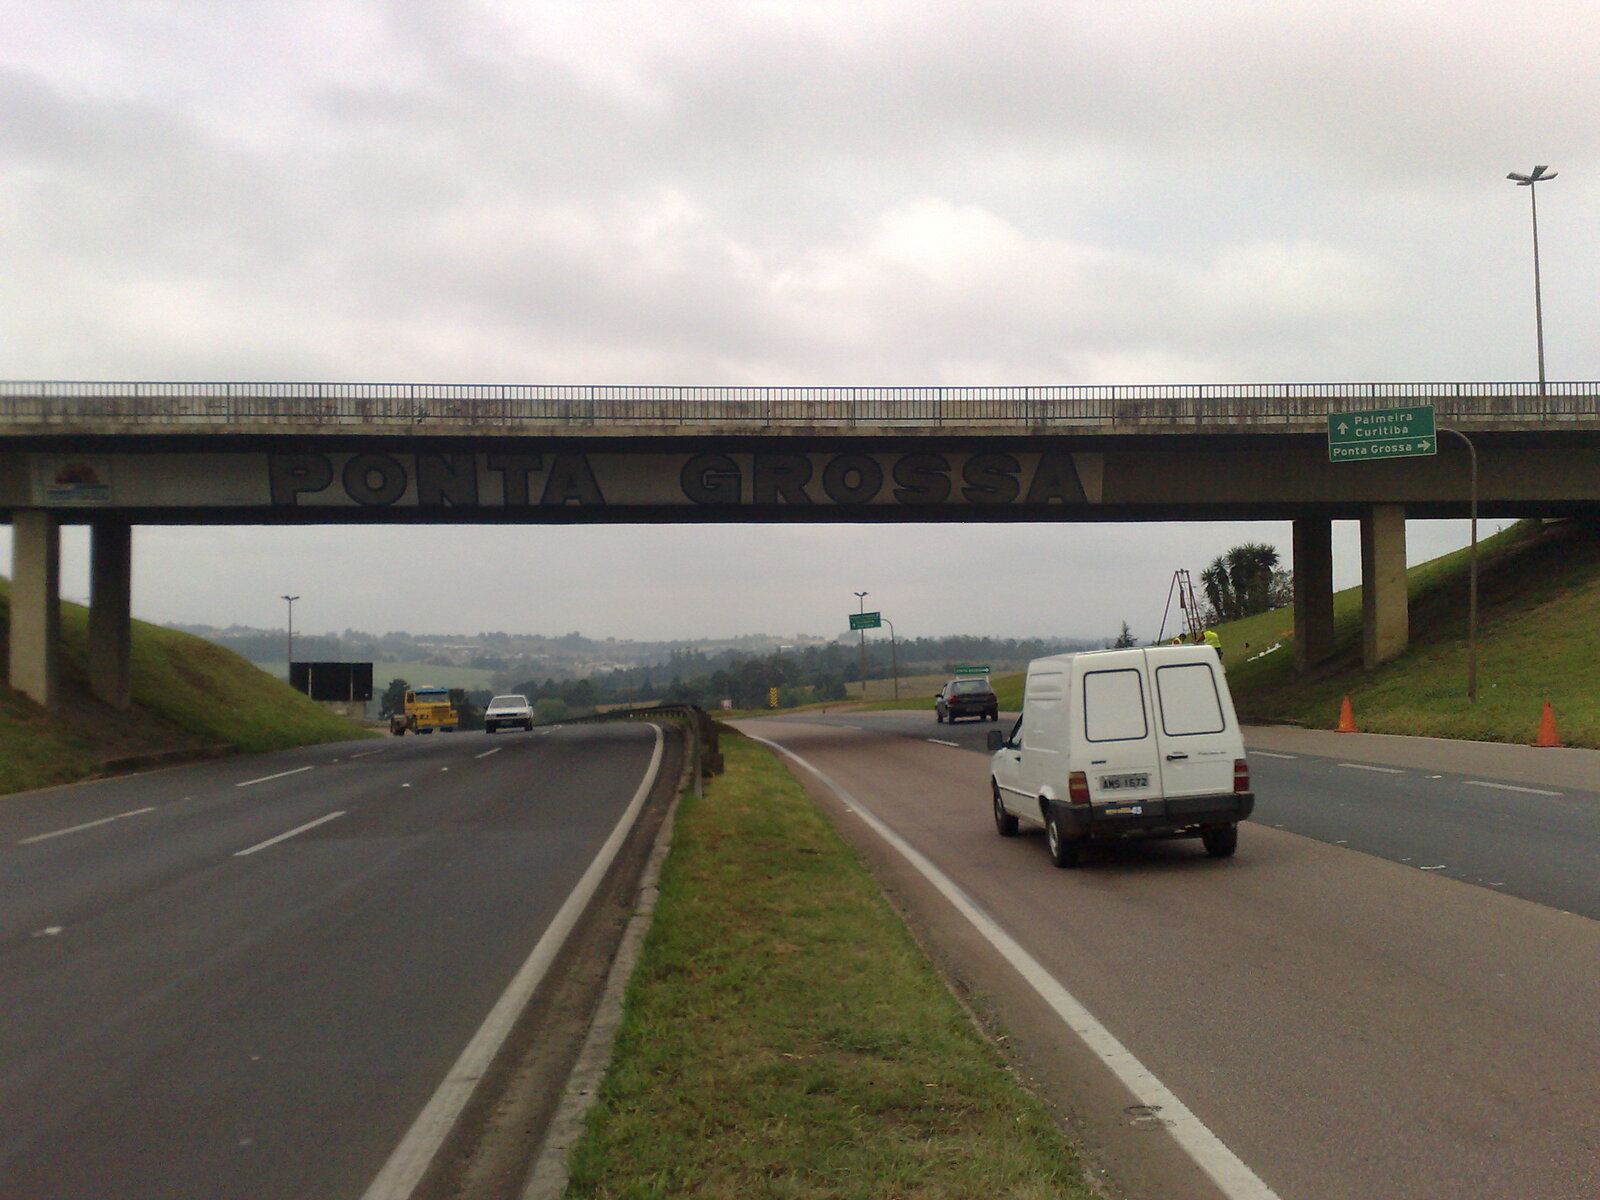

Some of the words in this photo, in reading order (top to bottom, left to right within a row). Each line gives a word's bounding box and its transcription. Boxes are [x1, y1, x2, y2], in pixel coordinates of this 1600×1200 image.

[1354, 413, 1413, 425] Palmeira
[1355, 426, 1409, 437] Curitiba
[1333, 447, 1368, 457] Ponta
[1370, 443, 1412, 454] Grossa
[269, 452, 606, 506] PONTA
[680, 452, 1089, 505] GROSSA
